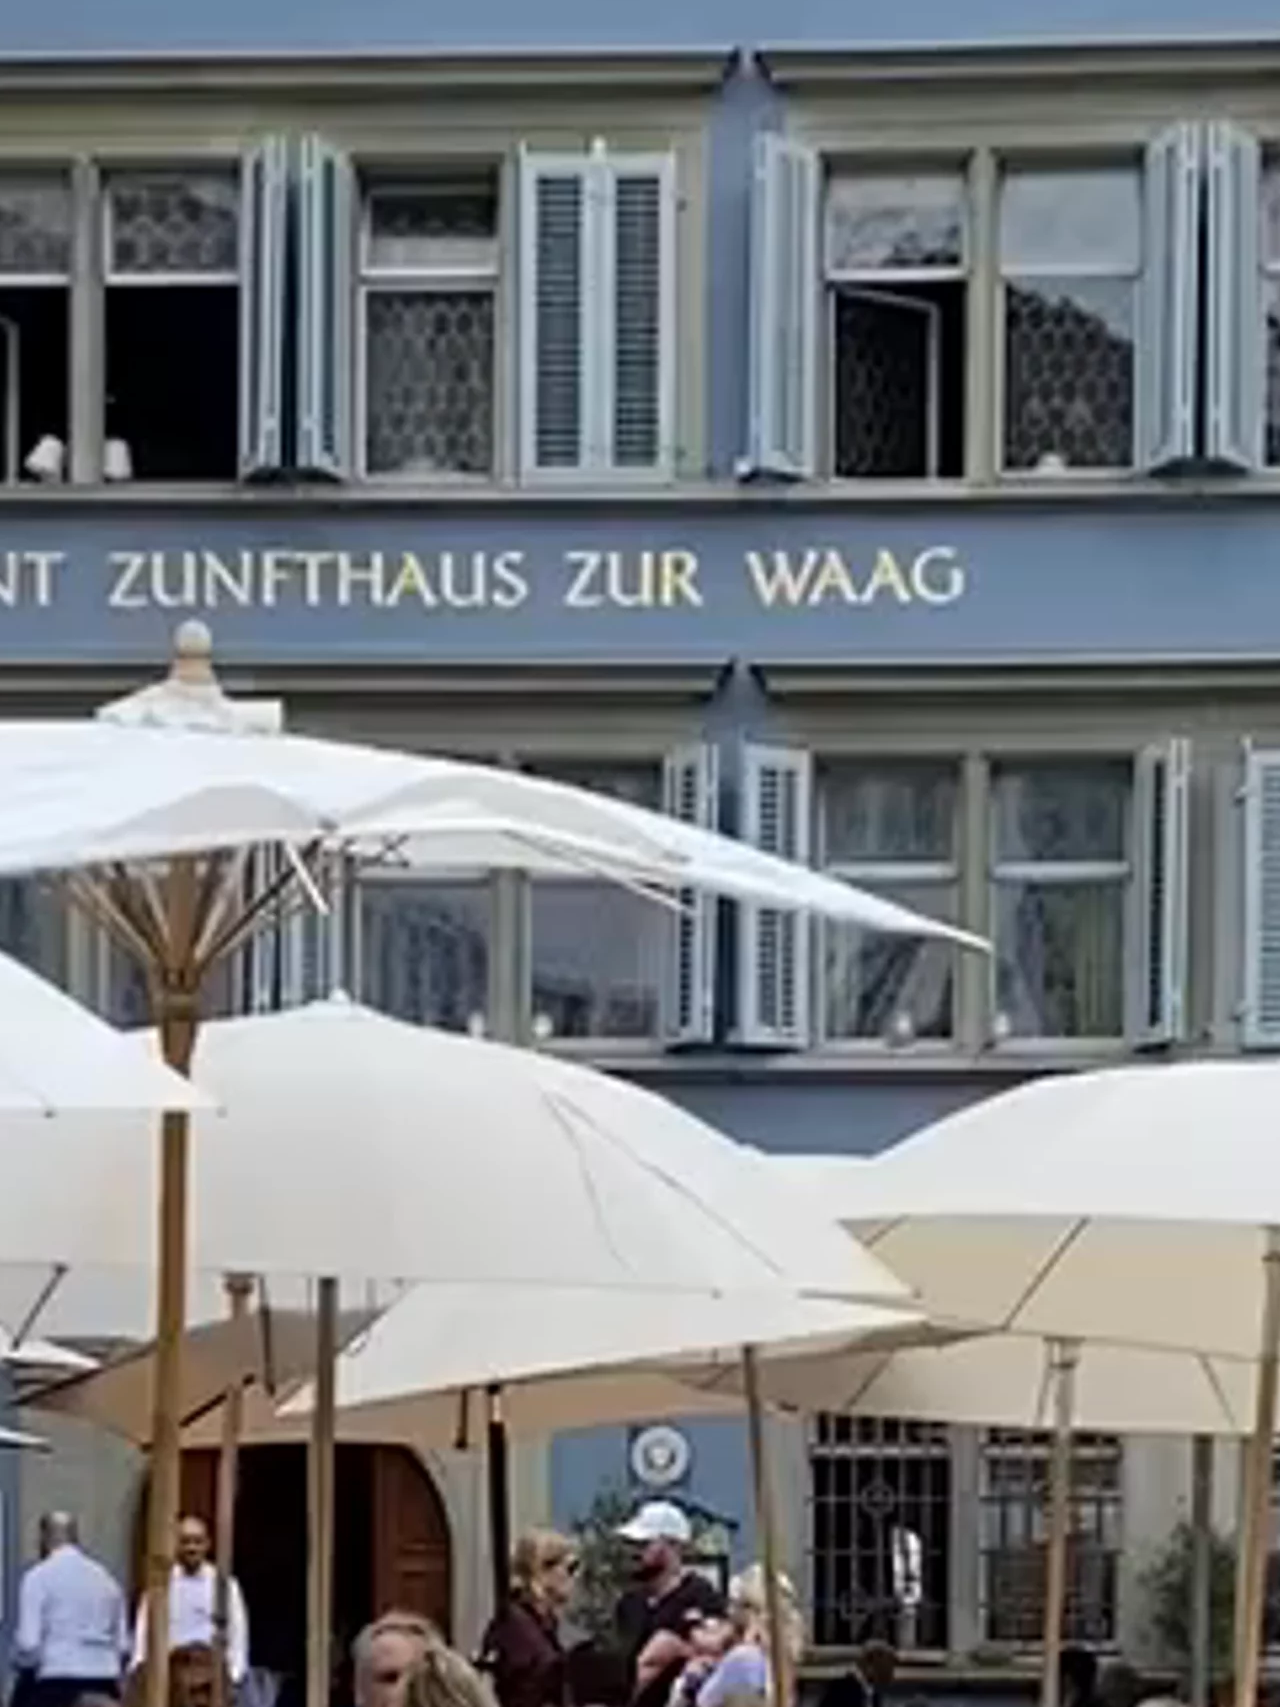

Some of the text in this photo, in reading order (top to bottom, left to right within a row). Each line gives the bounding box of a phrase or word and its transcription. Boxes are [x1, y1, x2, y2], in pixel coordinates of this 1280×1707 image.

[108, 549, 529, 609] ZUNFTHAUS
[564, 549, 704, 608] ZUR
[746, 544, 966, 607] WAAG
